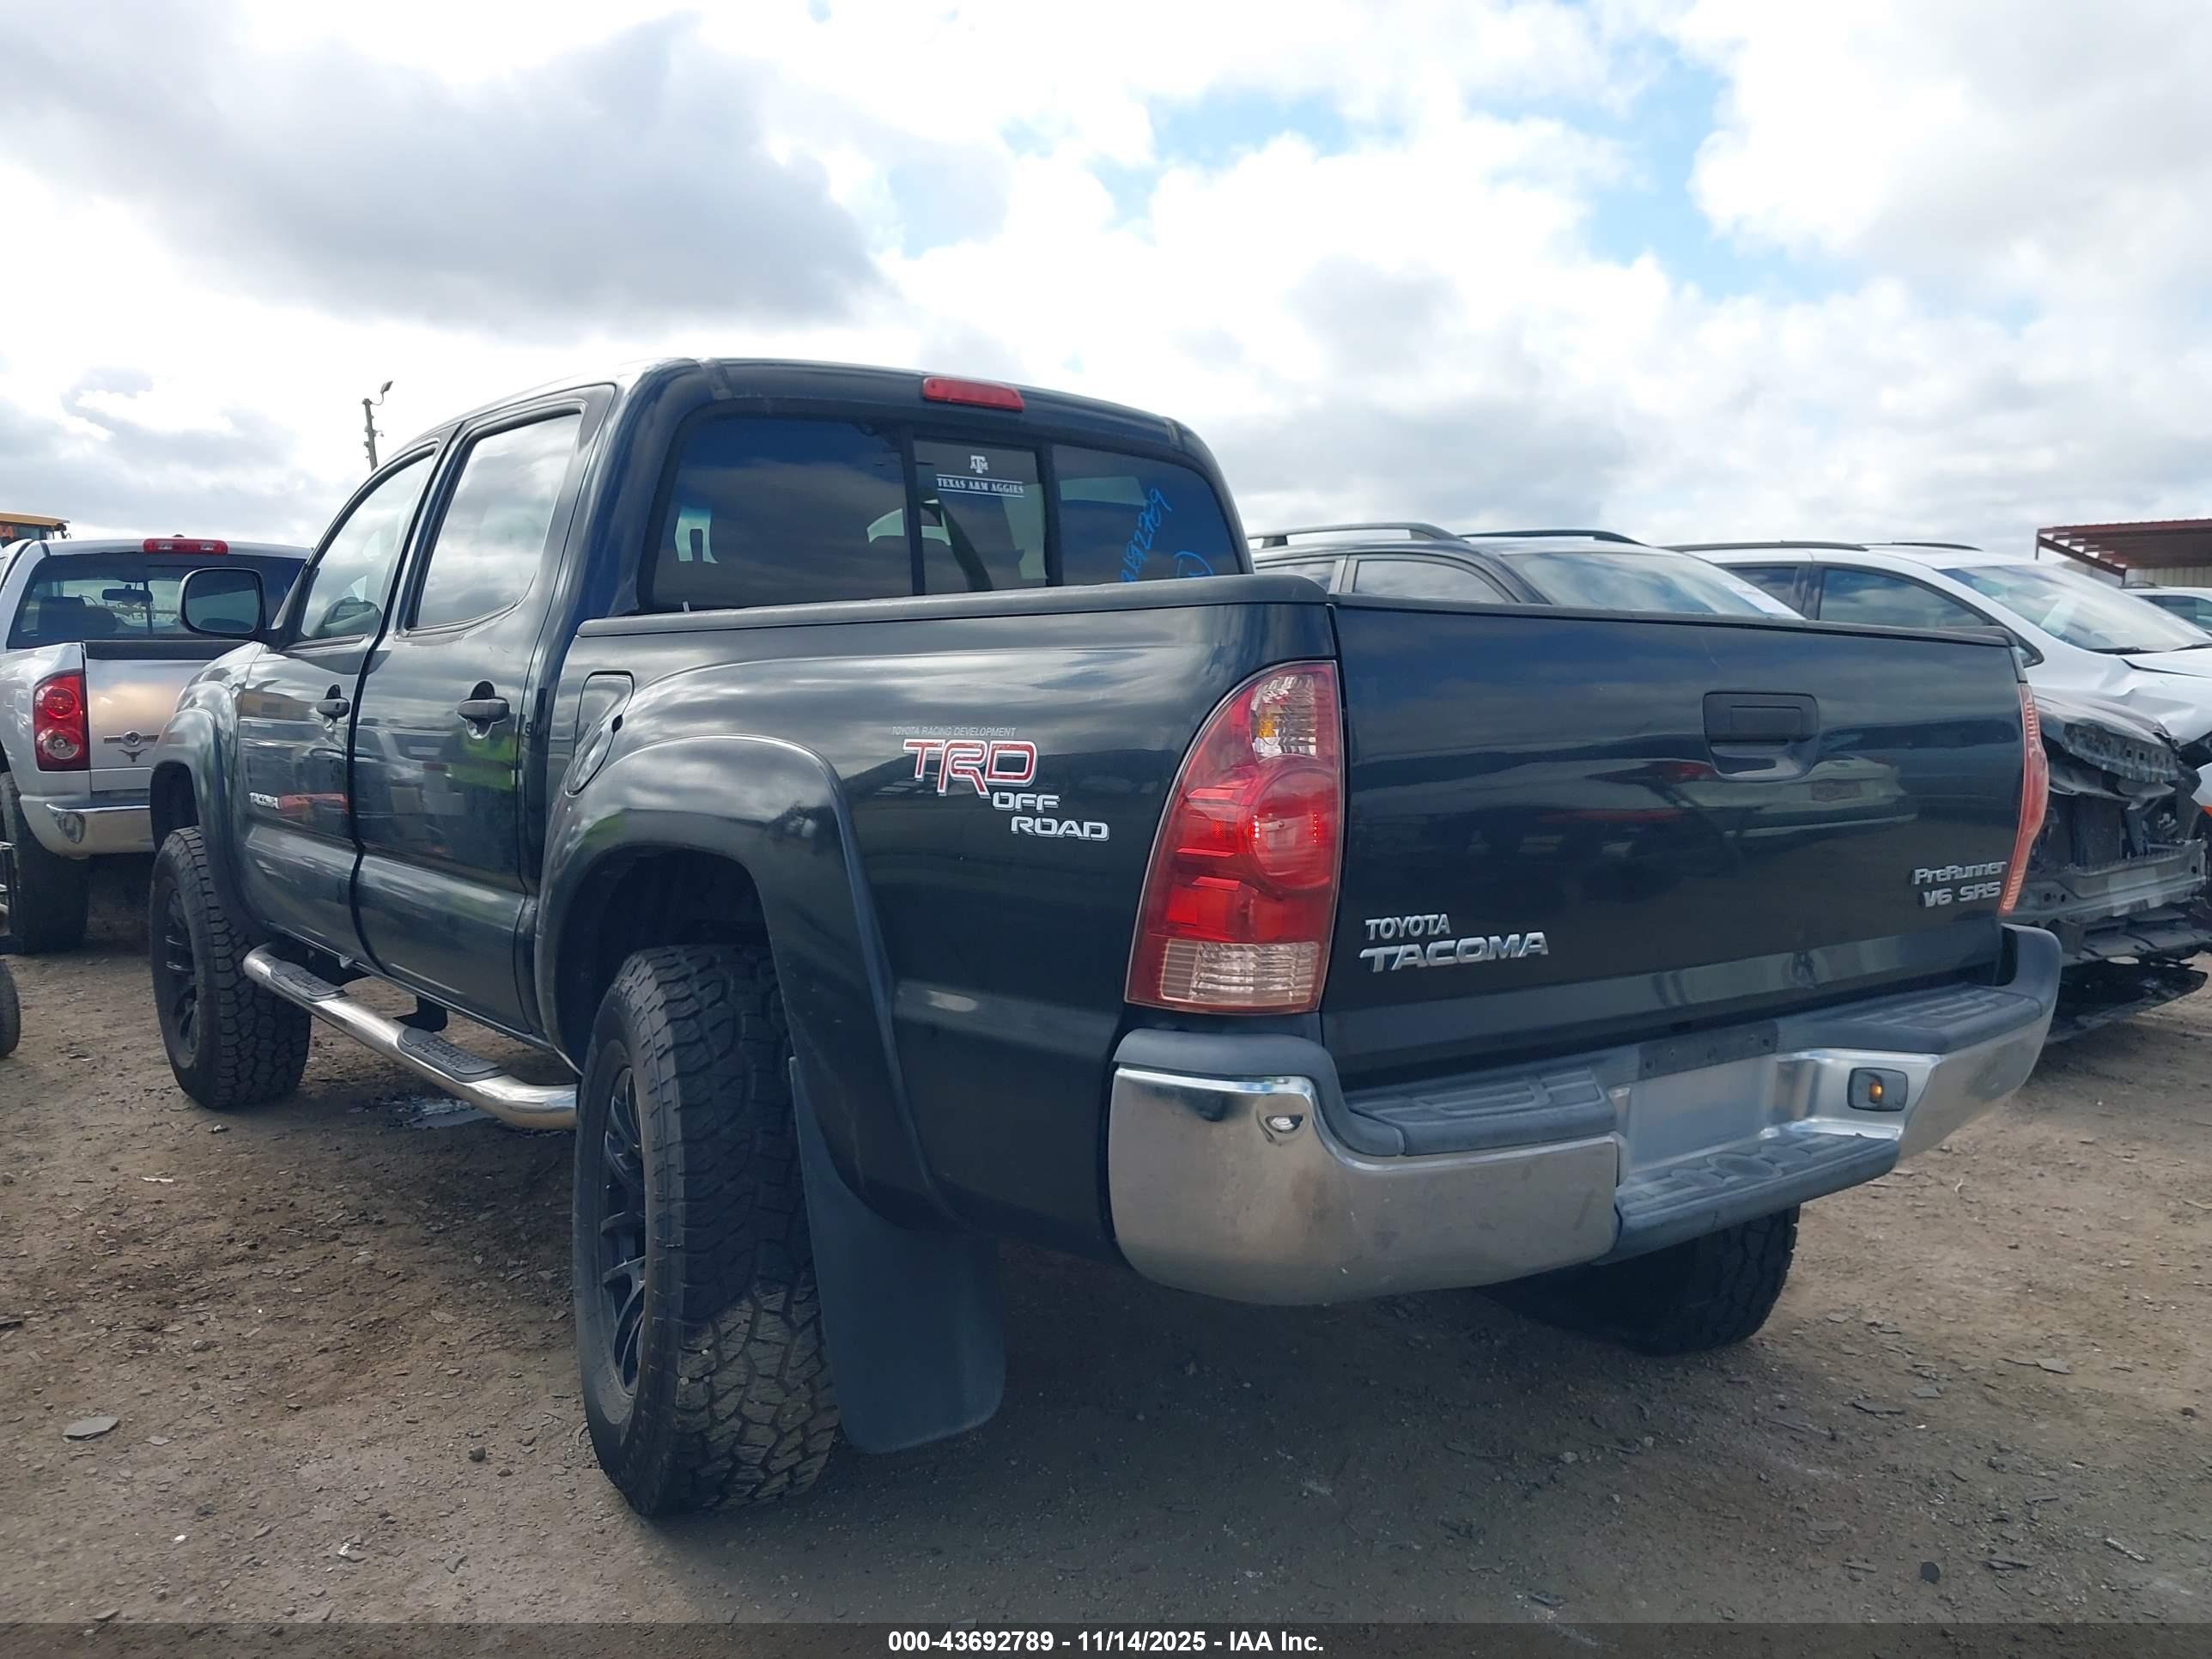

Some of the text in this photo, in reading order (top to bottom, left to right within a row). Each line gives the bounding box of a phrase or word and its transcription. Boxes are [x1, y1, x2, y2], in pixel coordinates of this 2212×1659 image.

[936, 477, 966, 489] TEXAS
[991, 483, 1024, 495] AGGIES
[892, 726, 1017, 737] TOYOTA RACING DEVELOPMENT
[902, 738, 1038, 799] TRD
[993, 791, 1061, 813] OFF
[1011, 816, 1110, 842] ROAD
[1914, 861, 2008, 885] PreRunner
[1923, 888, 1953, 908] V6
[1365, 914, 1451, 940] TOYOTA
[1359, 932, 1549, 973] TACOMA
